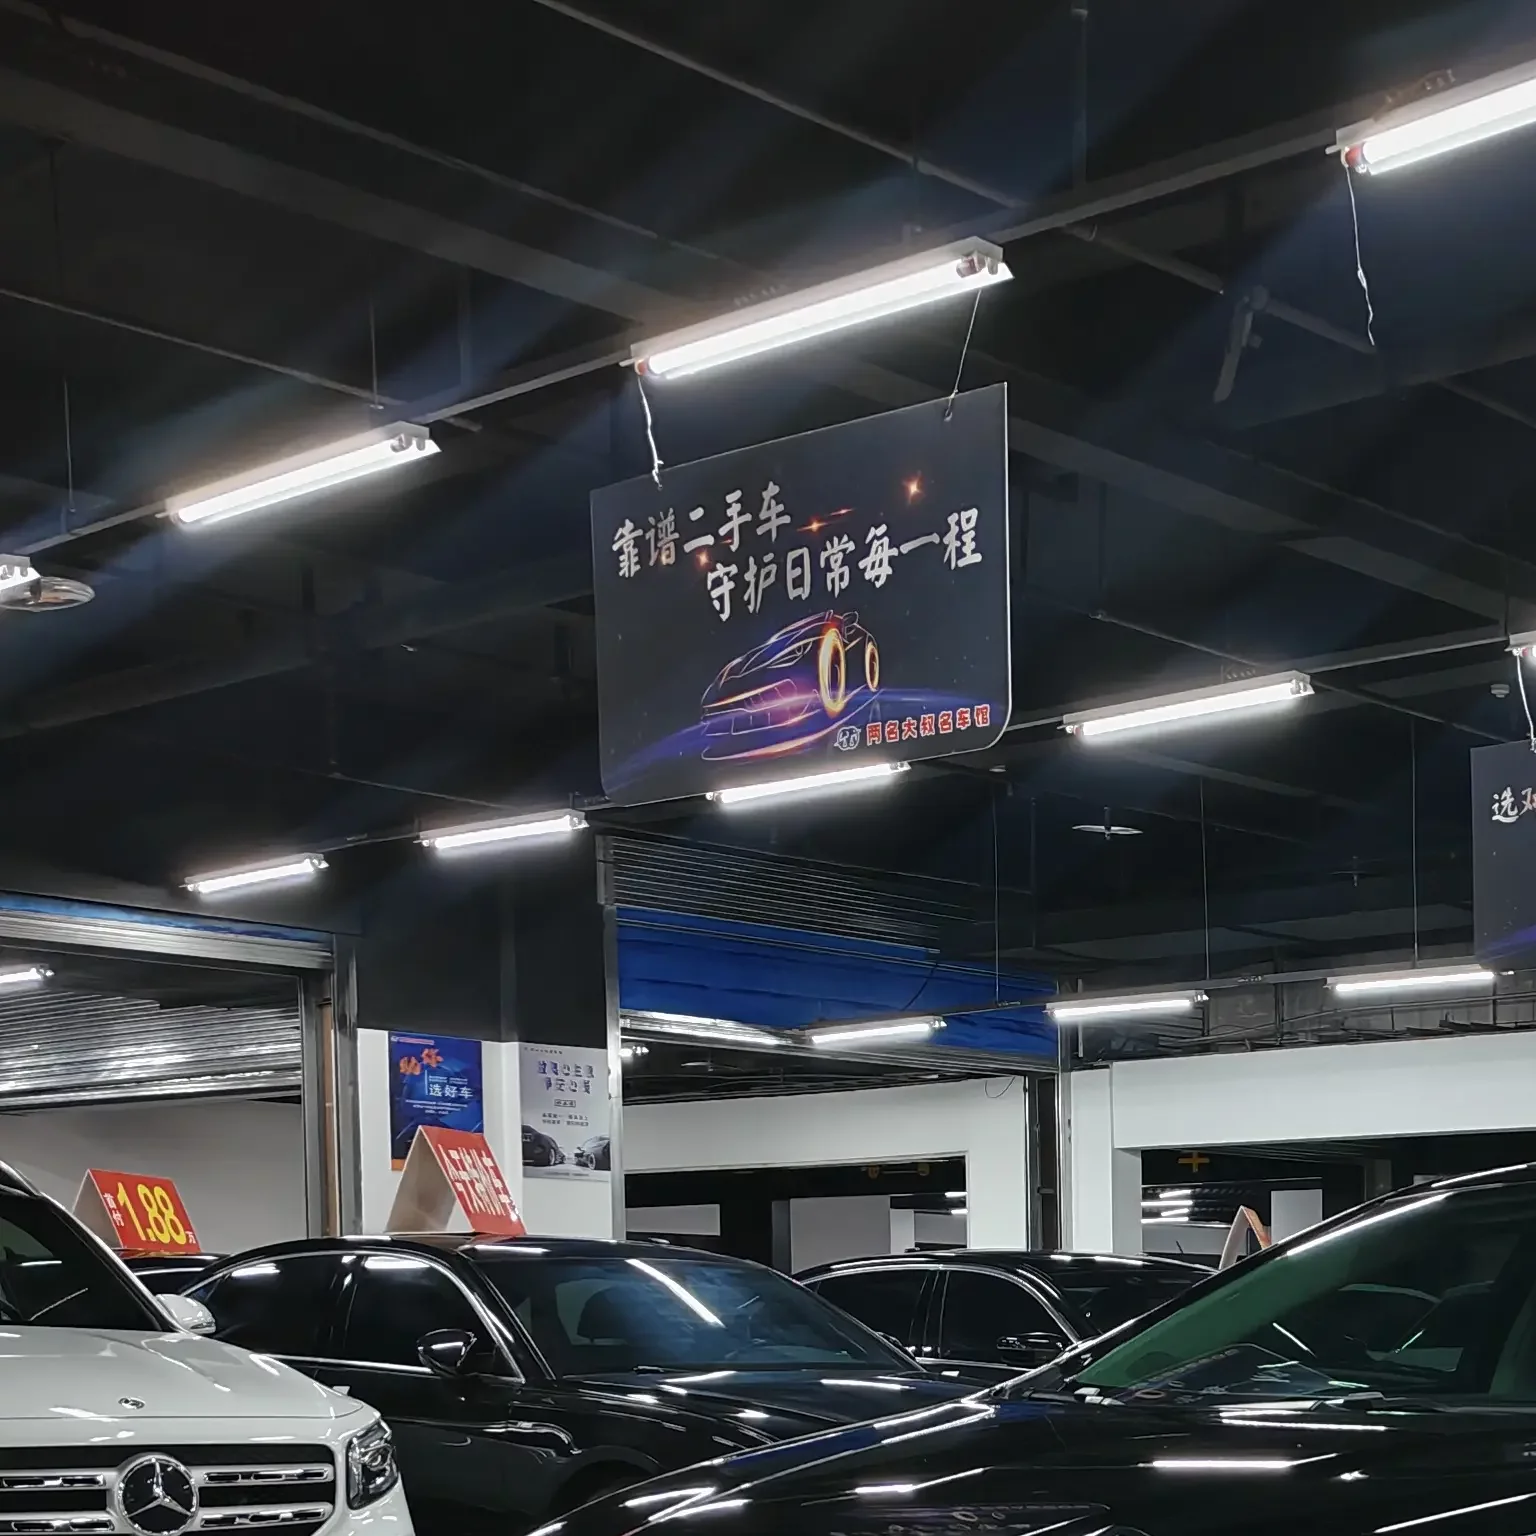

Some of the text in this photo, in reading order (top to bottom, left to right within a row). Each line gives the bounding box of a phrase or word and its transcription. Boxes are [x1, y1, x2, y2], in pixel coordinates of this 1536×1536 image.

[612, 481, 792, 578] 靠谱二手车
[706, 507, 983, 622] 守护日常每一程
[866, 704, 991, 746] 两名大叔名车馆
[429, 1084, 474, 1099] 选好车
[117, 1181, 186, 1245] 1.88
